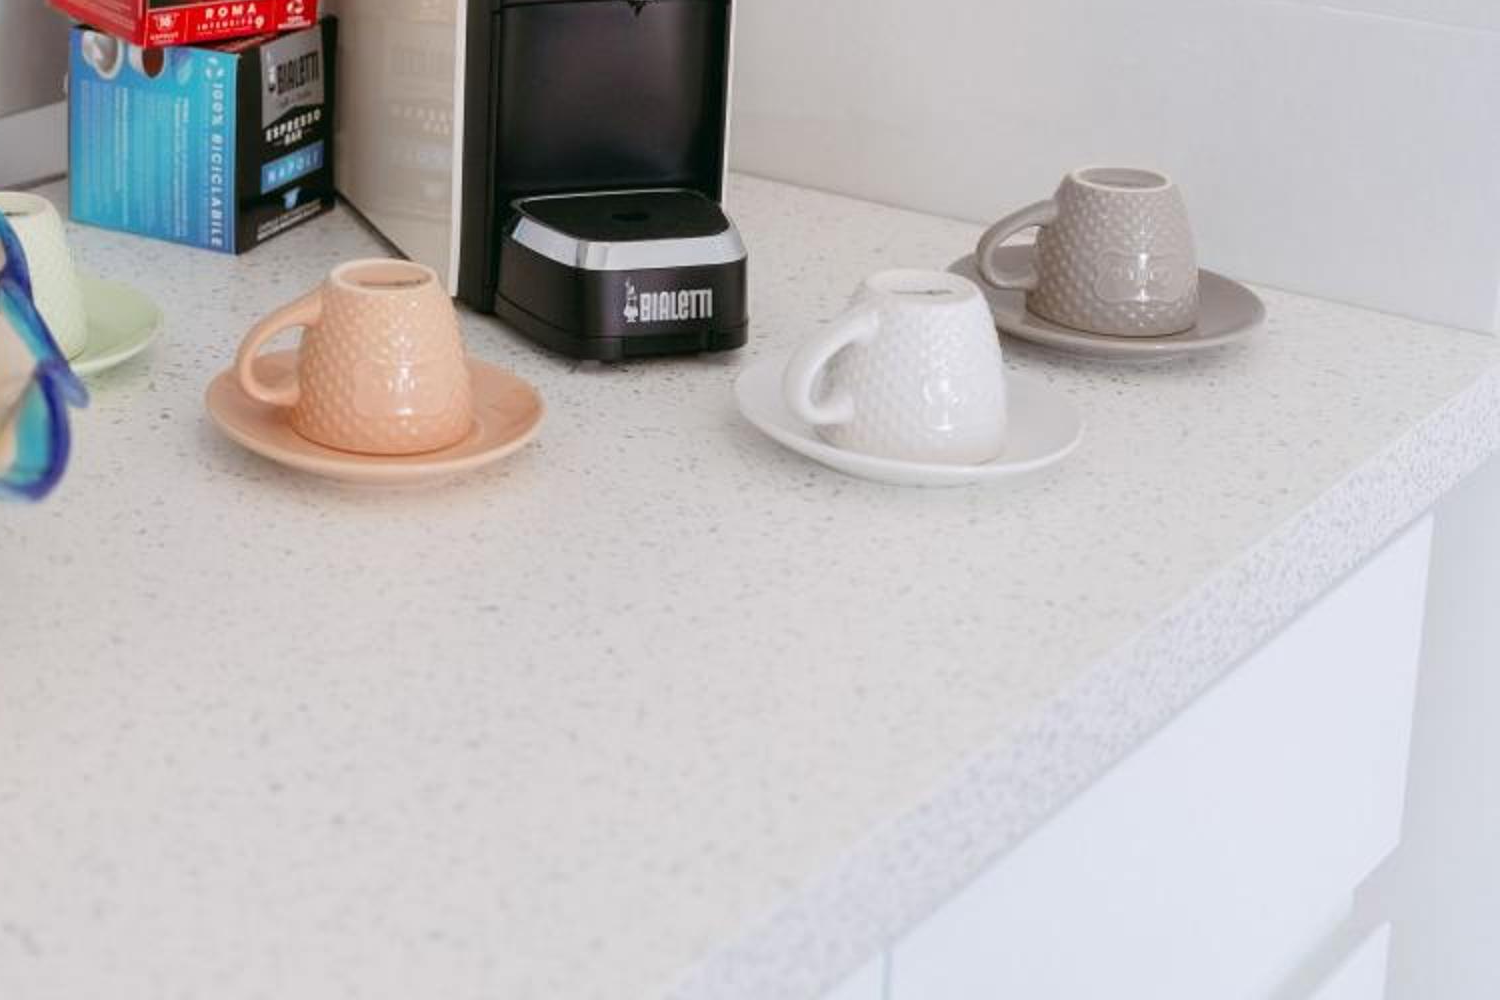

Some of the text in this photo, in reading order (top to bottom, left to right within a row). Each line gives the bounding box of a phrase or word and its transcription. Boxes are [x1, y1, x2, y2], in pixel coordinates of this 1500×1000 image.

[205, 3, 257, 20] ROMA
[211, 82, 224, 126] 100%
[265, 108, 322, 143] ESPRESSO
[284, 129, 303, 146] BAR
[267, 154, 320, 185] NAPOLI
[639, 288, 713, 322] BIALETTI
